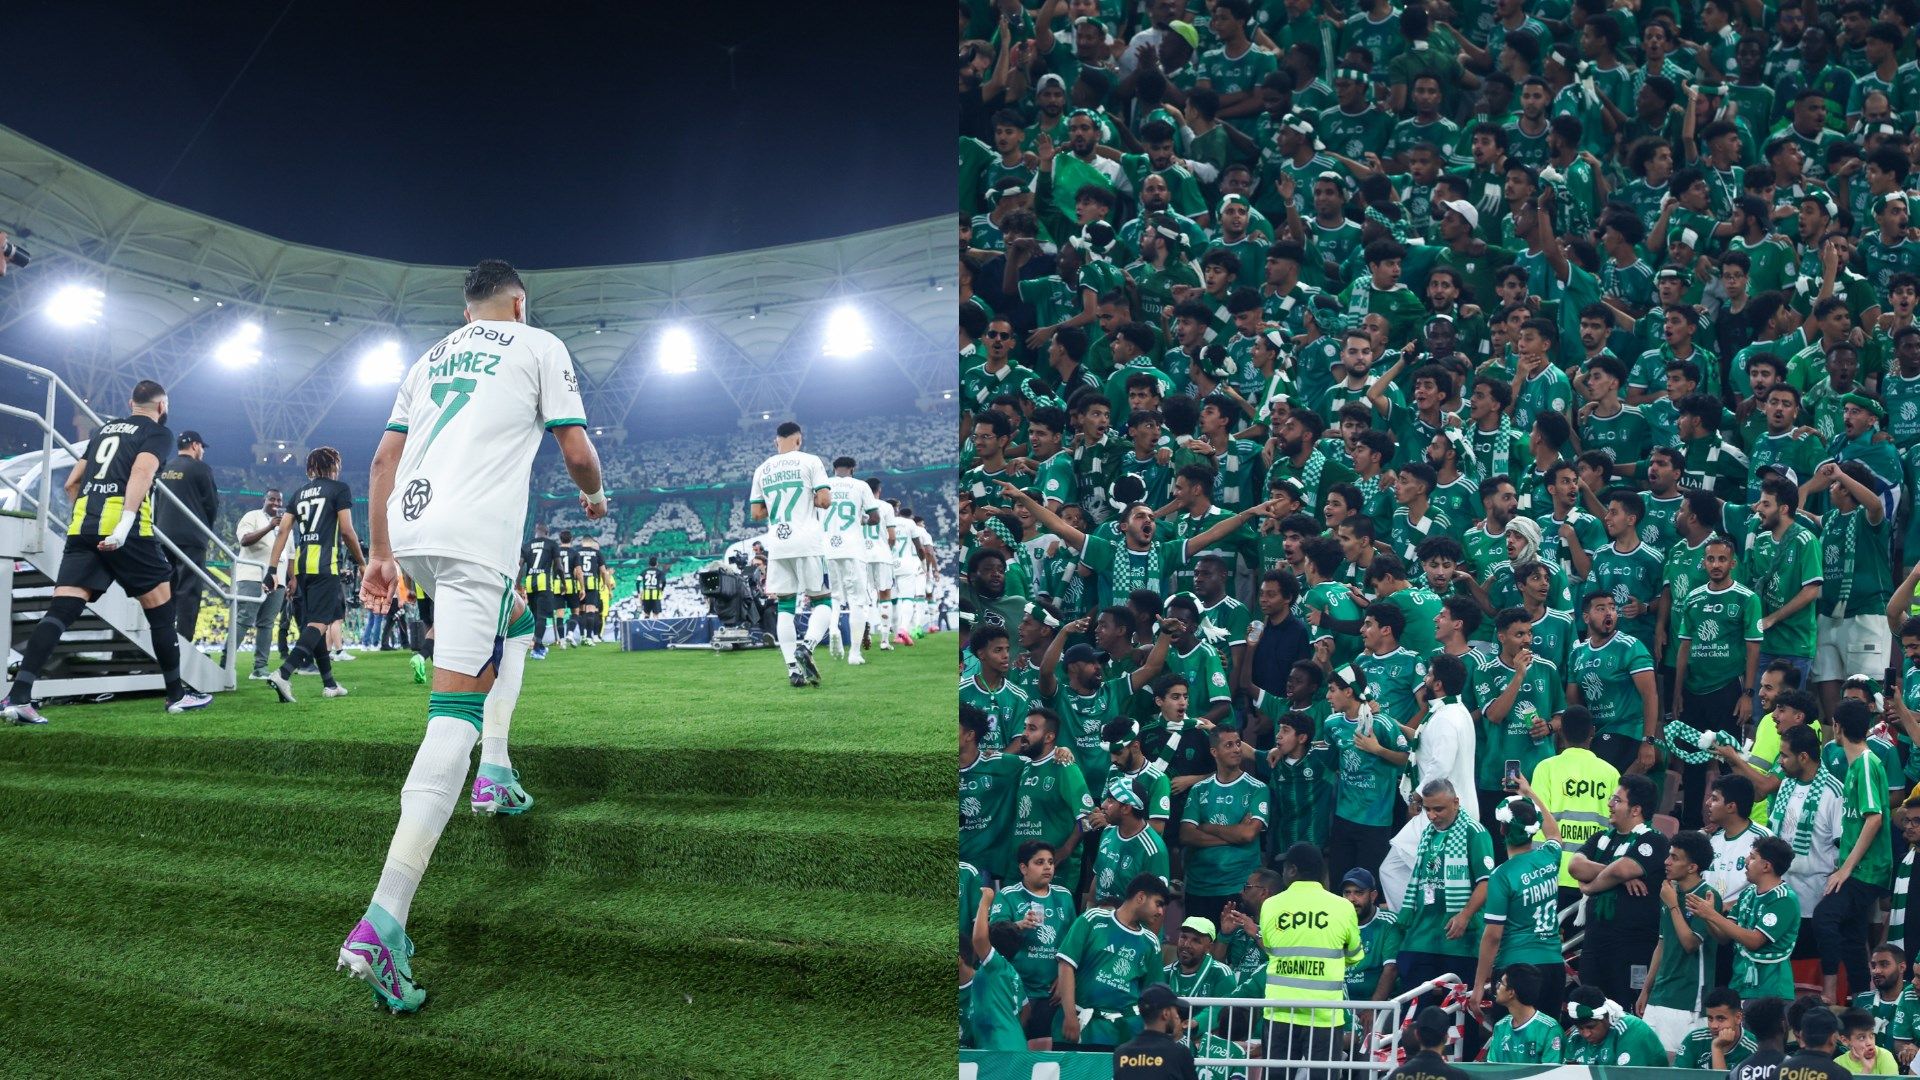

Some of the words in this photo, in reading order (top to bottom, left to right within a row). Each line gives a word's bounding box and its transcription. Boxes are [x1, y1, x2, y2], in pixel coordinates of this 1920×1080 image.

[452, 325, 515, 346] urpay
[428, 351, 501, 380] MAHREZ
[416, 377, 478, 470] 7
[93, 435, 120, 479] 9
[161, 470, 184, 480] olice
[762, 481, 804, 526] 77
[823, 501, 856, 532] 79
[1565, 779, 1607, 800] EPIC
[1528, 862, 1558, 880] urpay
[1278, 910, 1329, 930] EPIC
[1532, 898, 1558, 933] 10
[1275, 959, 1325, 977] ORGANIZER
[1120, 1054, 1164, 1068] Police
